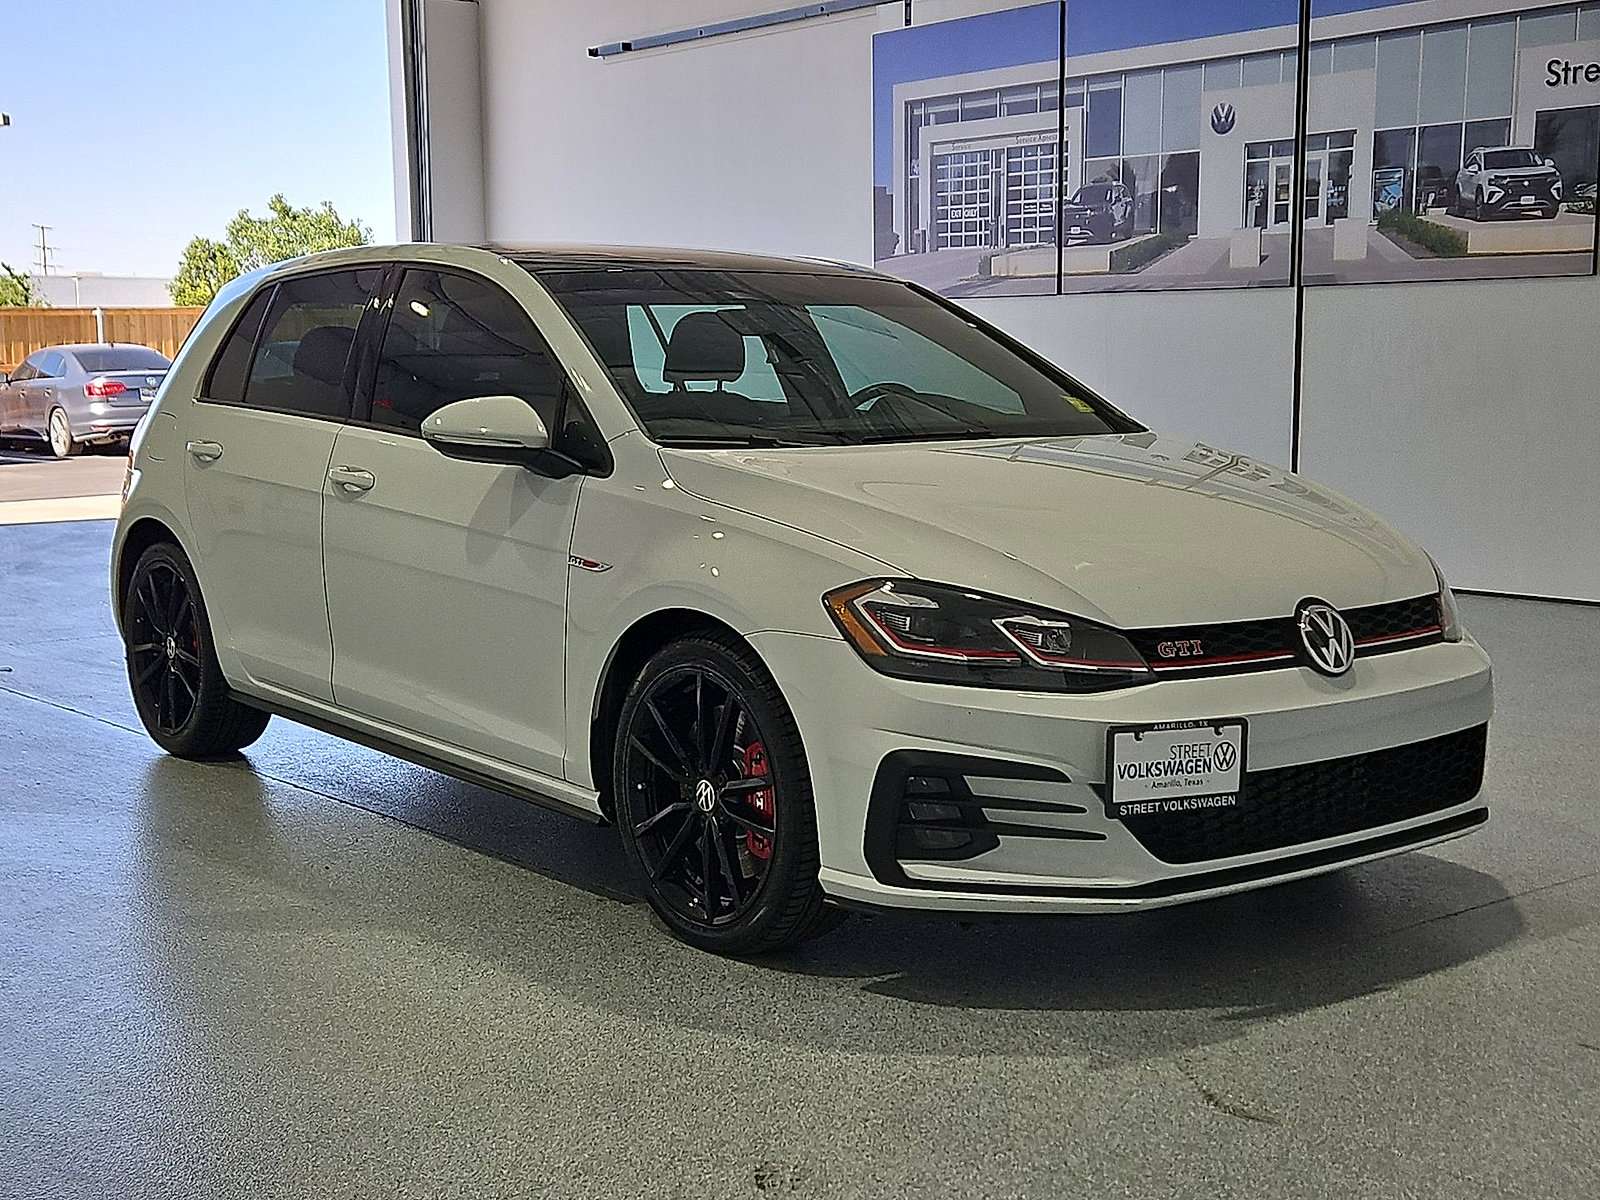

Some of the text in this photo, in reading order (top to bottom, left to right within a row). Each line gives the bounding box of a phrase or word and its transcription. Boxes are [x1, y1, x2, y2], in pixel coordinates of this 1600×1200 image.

[1545, 58, 1600, 87] Stre
[1157, 639, 1204, 658] GTI
[1169, 743, 1212, 760] STREET
[1117, 757, 1212, 780] VOLKSWAGEN
[1184, 778, 1204, 787] Texas
[1119, 794, 1236, 816] STREET VOLKSWAGEN
